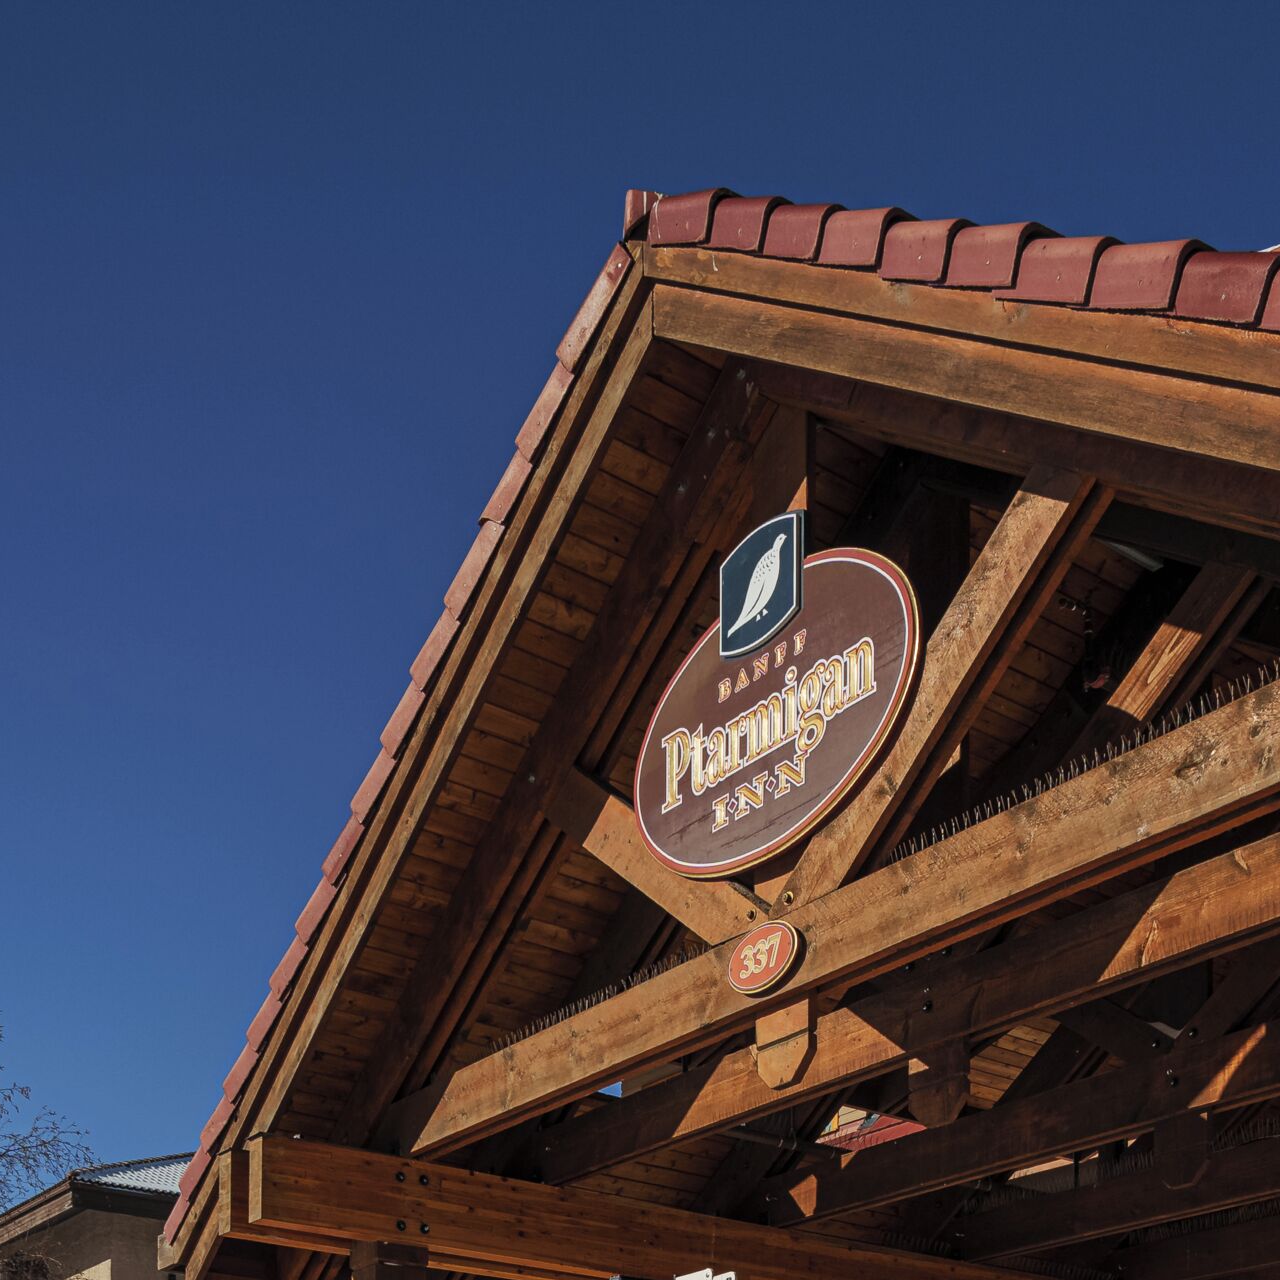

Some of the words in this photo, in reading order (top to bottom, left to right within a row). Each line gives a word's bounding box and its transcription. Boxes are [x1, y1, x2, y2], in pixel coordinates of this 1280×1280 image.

[718, 629, 806, 703] BANFF
[662, 637, 876, 814] Ptarmigan
[740, 931, 782, 979] 337
